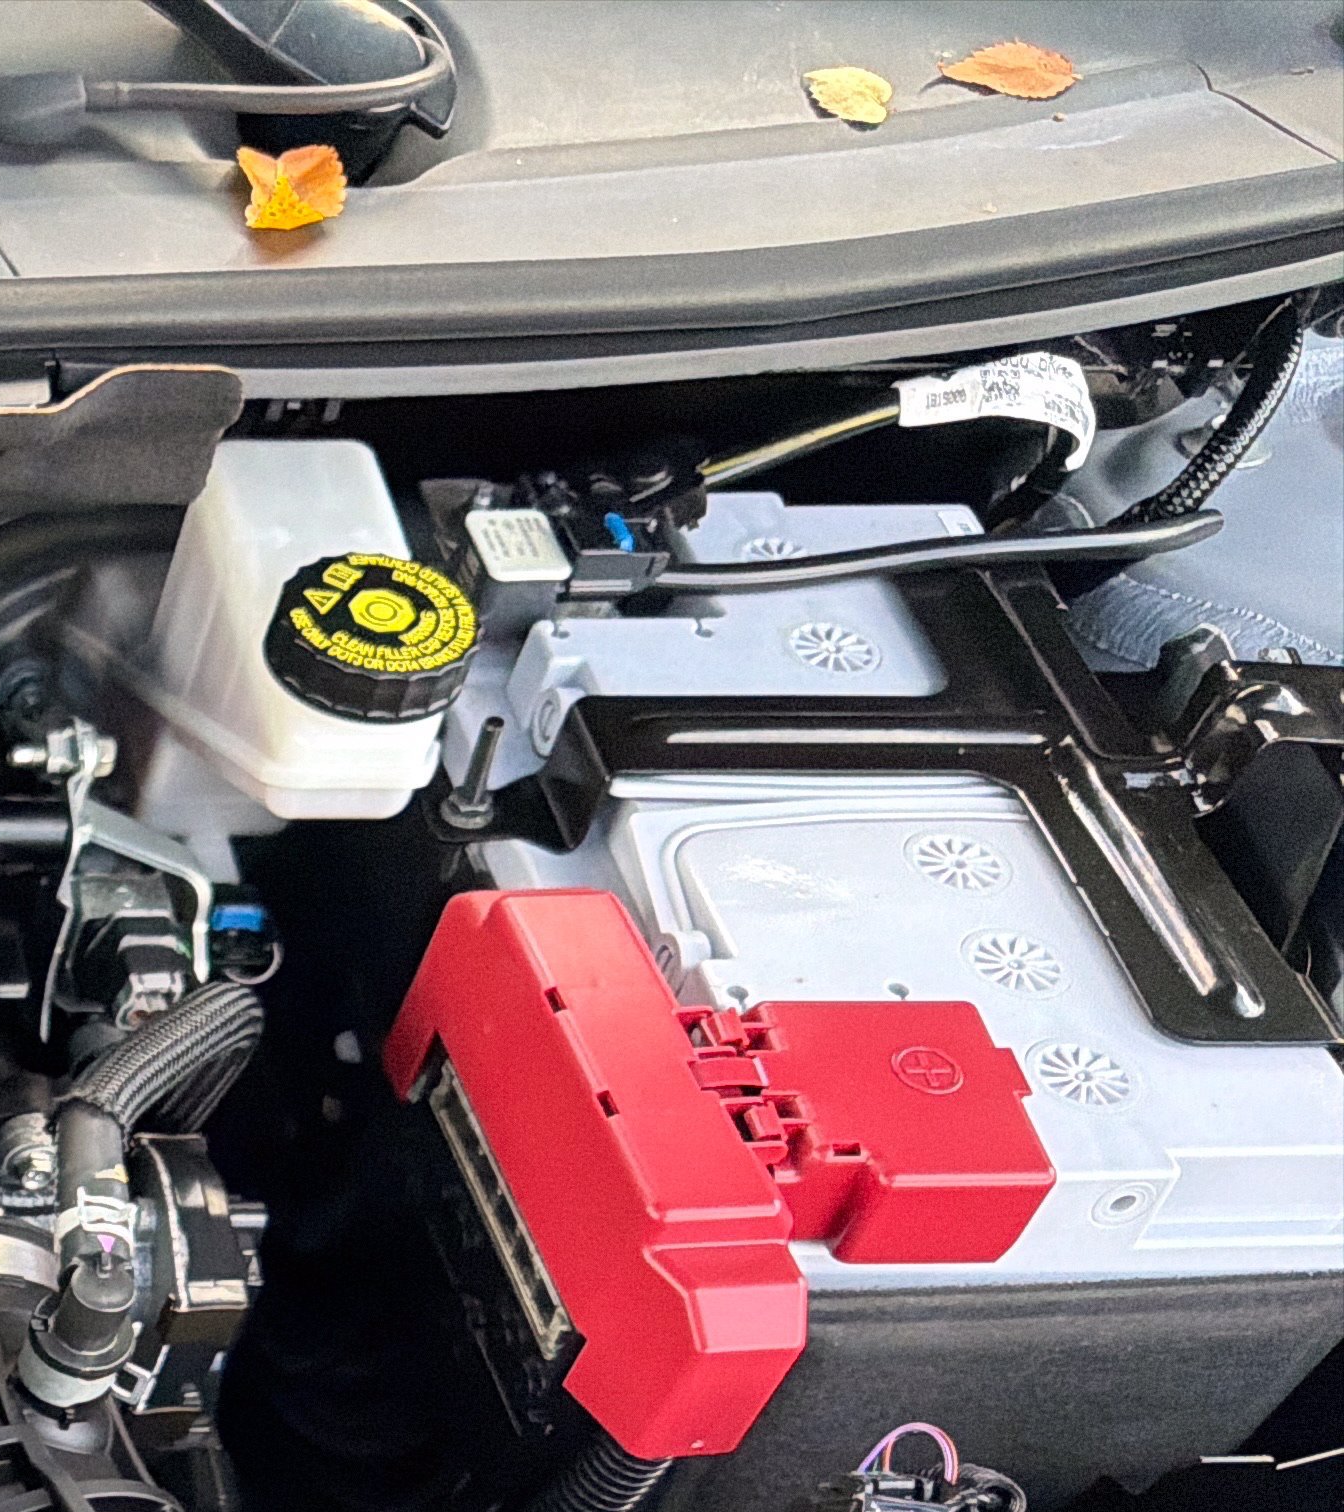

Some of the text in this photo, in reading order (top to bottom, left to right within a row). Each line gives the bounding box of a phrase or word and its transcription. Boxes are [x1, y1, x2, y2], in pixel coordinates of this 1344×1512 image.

[417, 567, 463, 600] SEALED
[301, 626, 331, 650] ONLY
[331, 630, 376, 658] CLEAN
[376, 645, 423, 660] FILLER
[417, 636, 443, 655] CAP
[436, 608, 455, 641] BEFORE
[327, 644, 364, 666] DOT3
[364, 657, 385, 671] OR
[385, 659, 421, 673] DOT4
[419, 646, 460, 670] BRAKE
